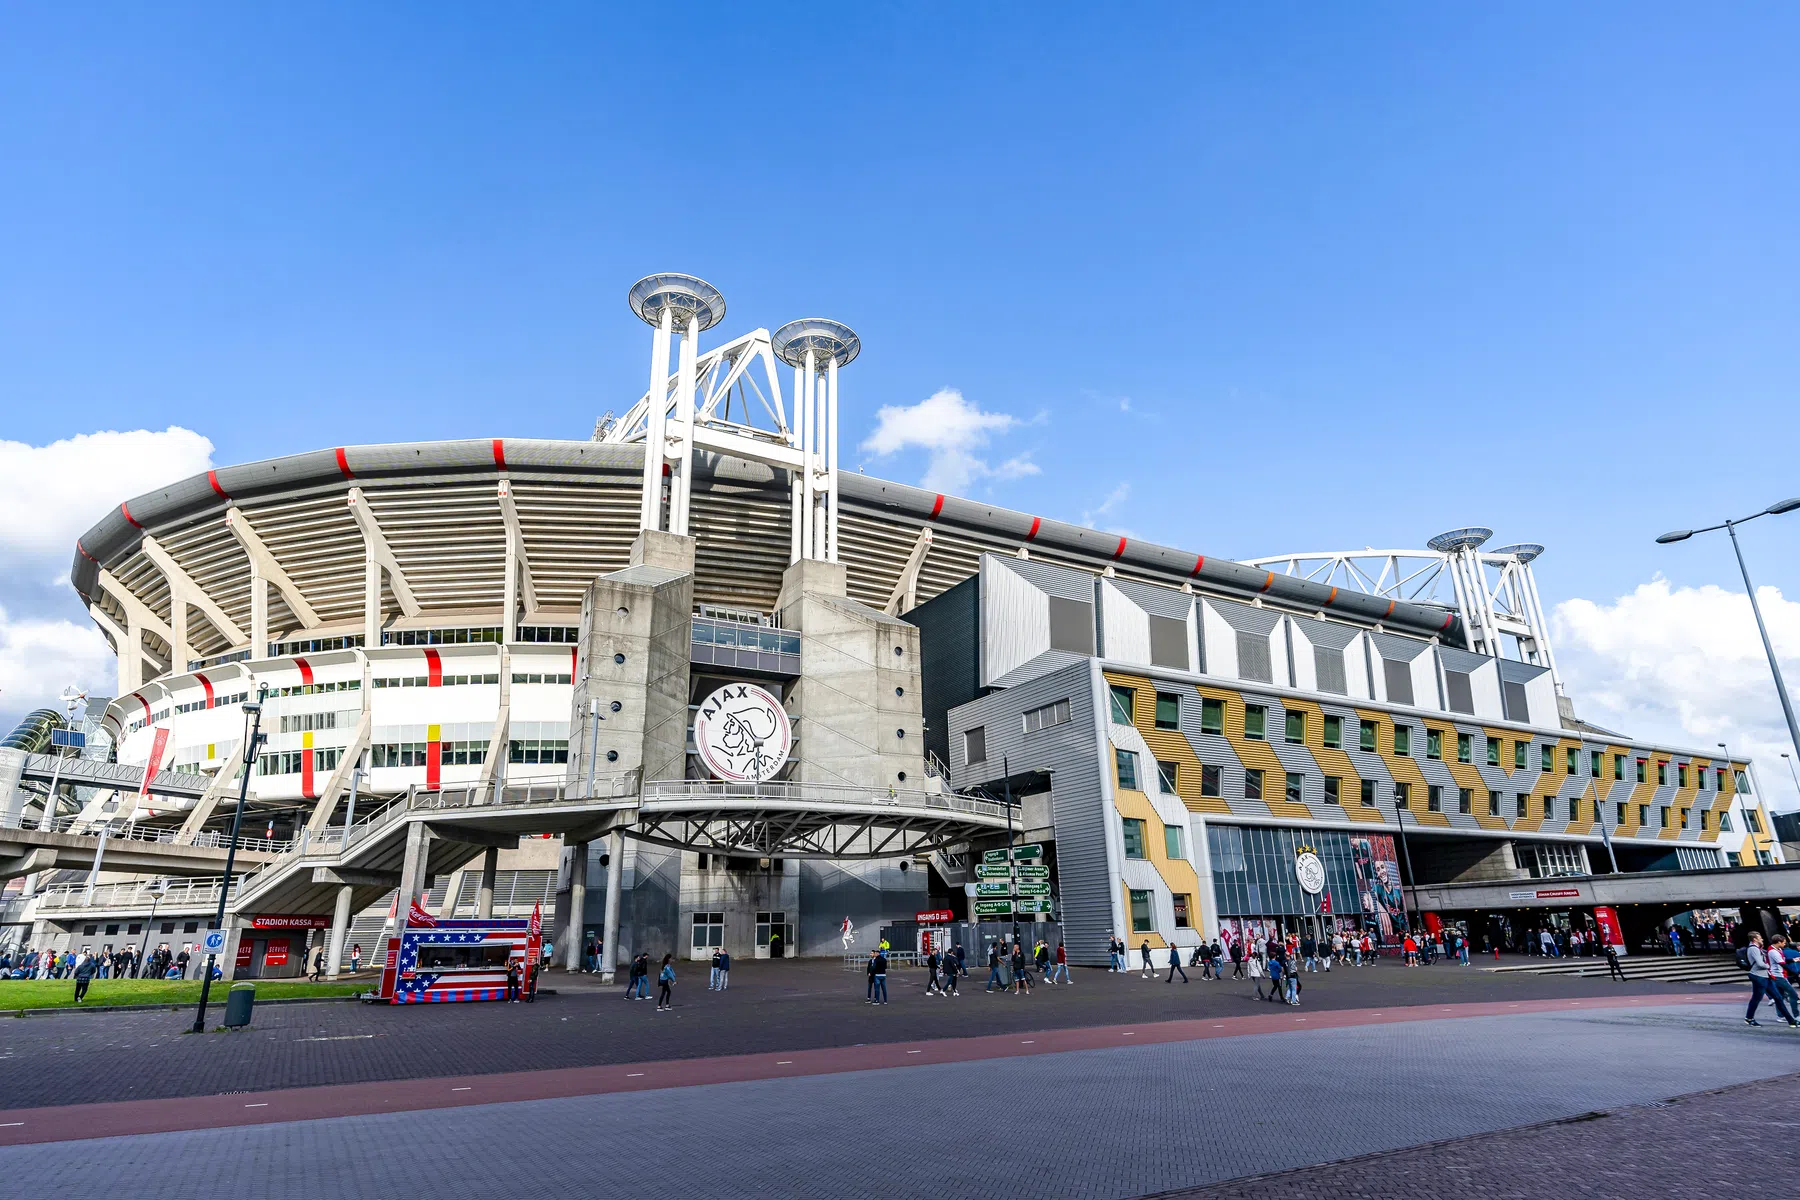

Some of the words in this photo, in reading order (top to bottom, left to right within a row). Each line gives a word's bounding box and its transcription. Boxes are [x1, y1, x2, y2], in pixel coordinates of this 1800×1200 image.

[702, 686, 748, 721] AJAX
[745, 750, 785, 781] AMSTERDAM
[1298, 854, 1308, 872] AJAX
[255, 918, 288, 926] STADION
[289, 918, 312, 926] KASSA
[917, 913, 936, 921] INGANG
